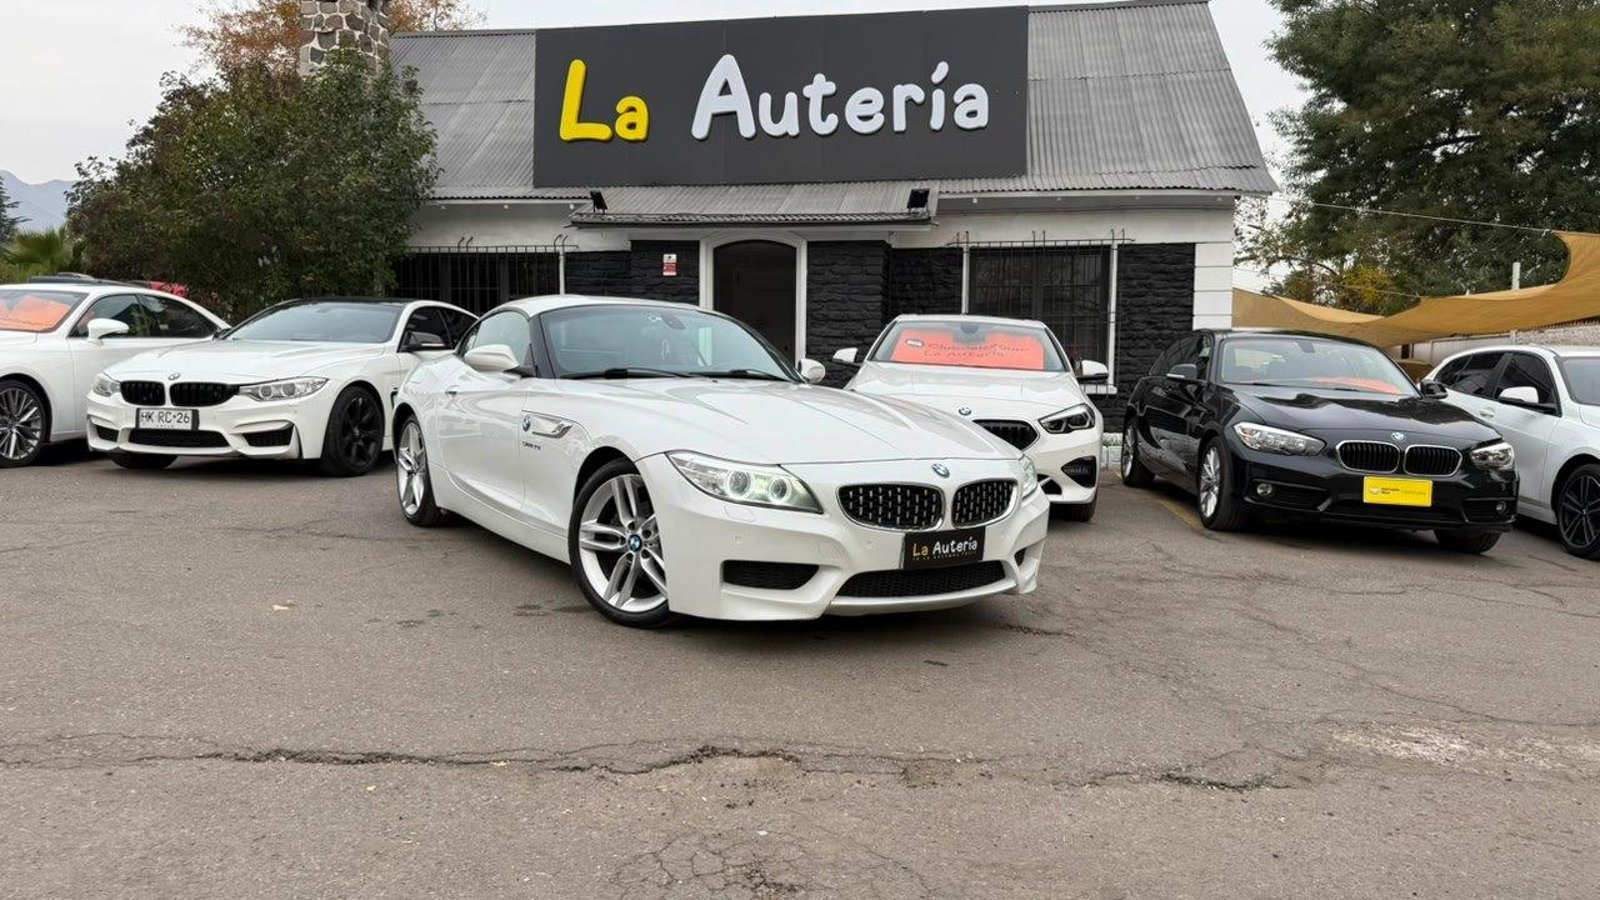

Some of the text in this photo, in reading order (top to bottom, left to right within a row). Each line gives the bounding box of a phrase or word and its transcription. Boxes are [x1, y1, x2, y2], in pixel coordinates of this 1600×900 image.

[559, 53, 989, 142] La Autería
[912, 542, 929, 557] La
[932, 536, 978, 554] Autería
